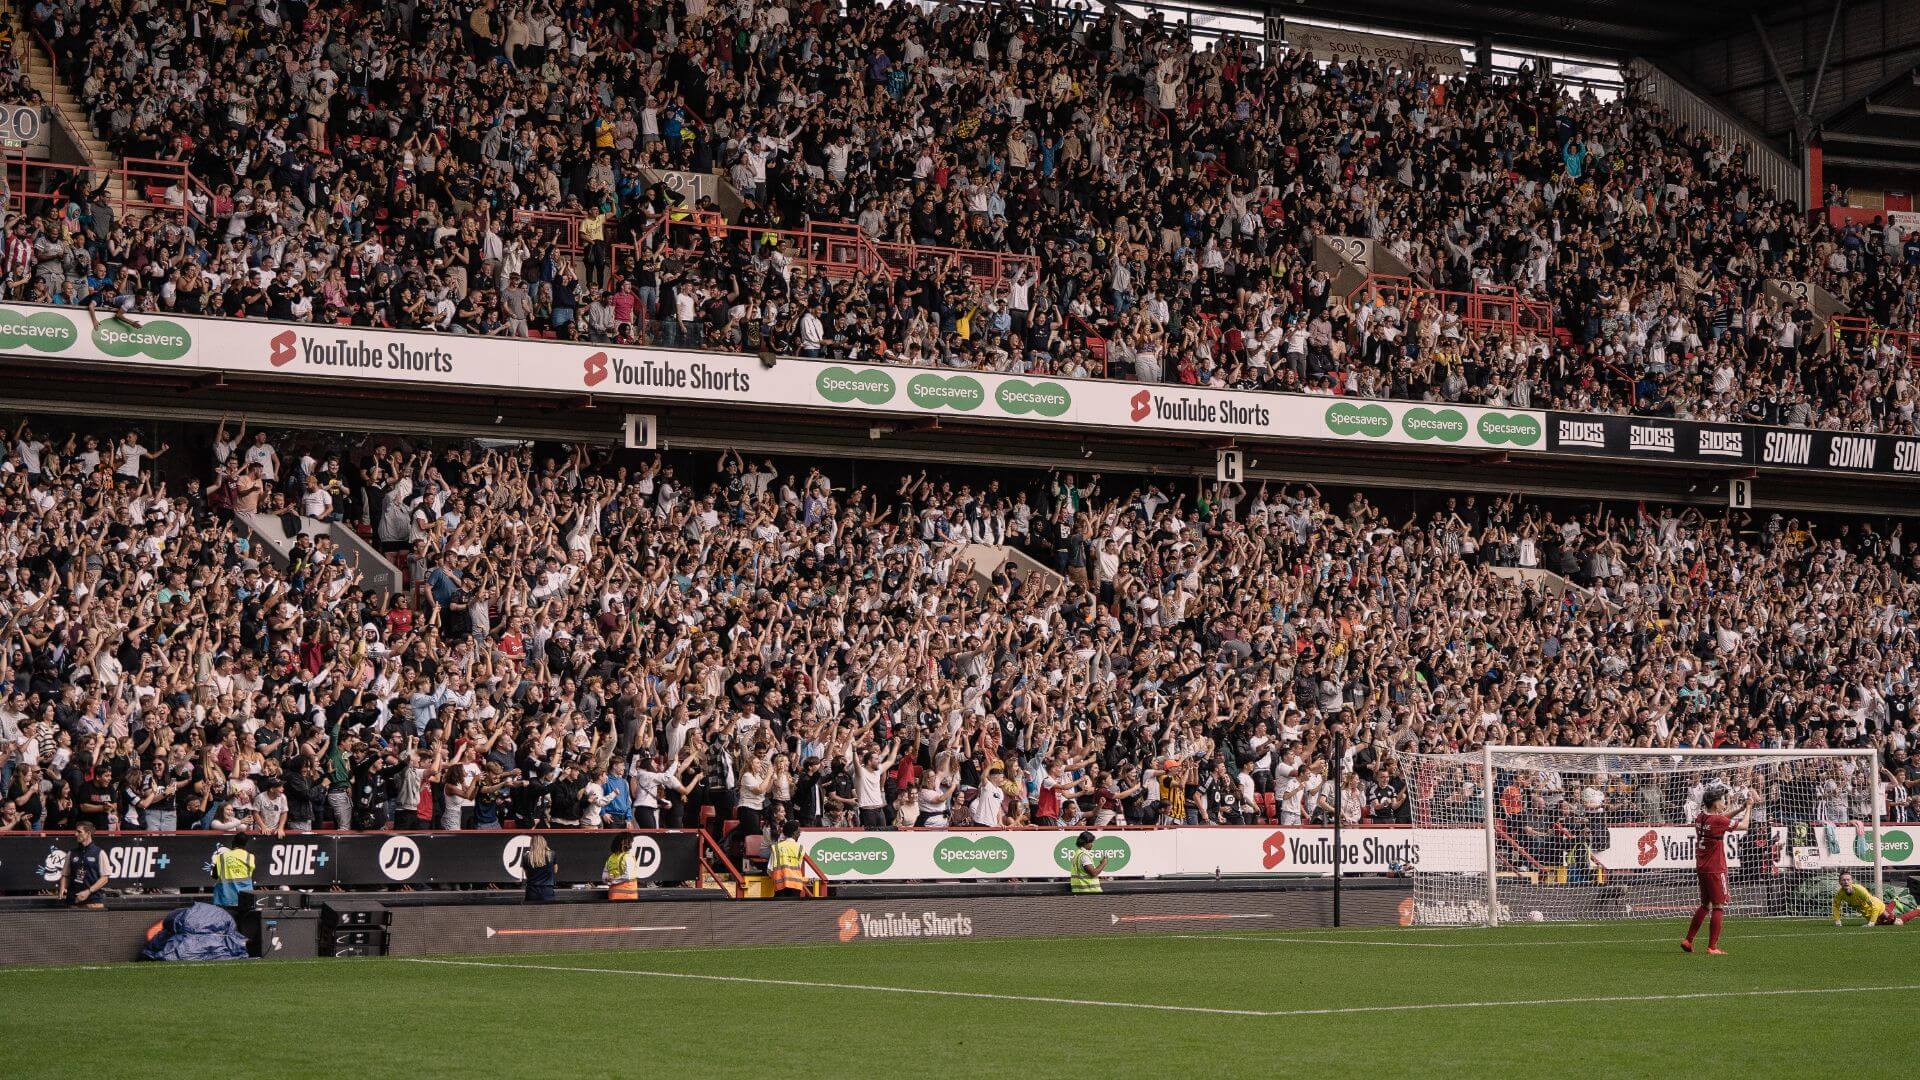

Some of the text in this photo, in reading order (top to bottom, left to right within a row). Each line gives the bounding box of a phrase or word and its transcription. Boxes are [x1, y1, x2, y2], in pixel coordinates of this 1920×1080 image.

[1268, 19, 1284, 40] M
[1329, 42, 1370, 55] south
[1375, 48, 1404, 60] east
[0, 324, 69, 339] ecsavers
[100, 329, 183, 347] Specsavers
[302, 337, 453, 373] YouTube Shorts
[612, 358, 750, 392] YouTube Shorts
[822, 376, 890, 394] Specsavers
[913, 382, 979, 400] Specsavers
[1001, 388, 1065, 406] Specsavers
[1154, 395, 1270, 426] YouTube Shorts
[1331, 410, 1388, 427] Specsavers
[634, 417, 649, 447] D
[1407, 416, 1464, 432] Specsavers
[1482, 420, 1537, 436] Specsavers
[1559, 420, 1605, 441] SIDES
[1629, 425, 1675, 446] SIDES
[1698, 429, 1743, 452] SIDES
[1763, 431, 1812, 465] SDMN
[1829, 436, 1877, 469] SDMN
[1225, 452, 1237, 481] C
[1735, 481, 1746, 506] B
[385, 847, 415, 869] JD
[816, 849, 888, 866] Specsavers
[940, 848, 1008, 864] Specsavers
[1061, 847, 1125, 862] Spsavers
[1362, 837, 1420, 865] Shorts
[1661, 835, 1696, 861] YouT
[109, 846, 170, 879] SIDE+
[269, 844, 329, 876] SIDE+
[860, 911, 973, 938] YouTube Shorts
